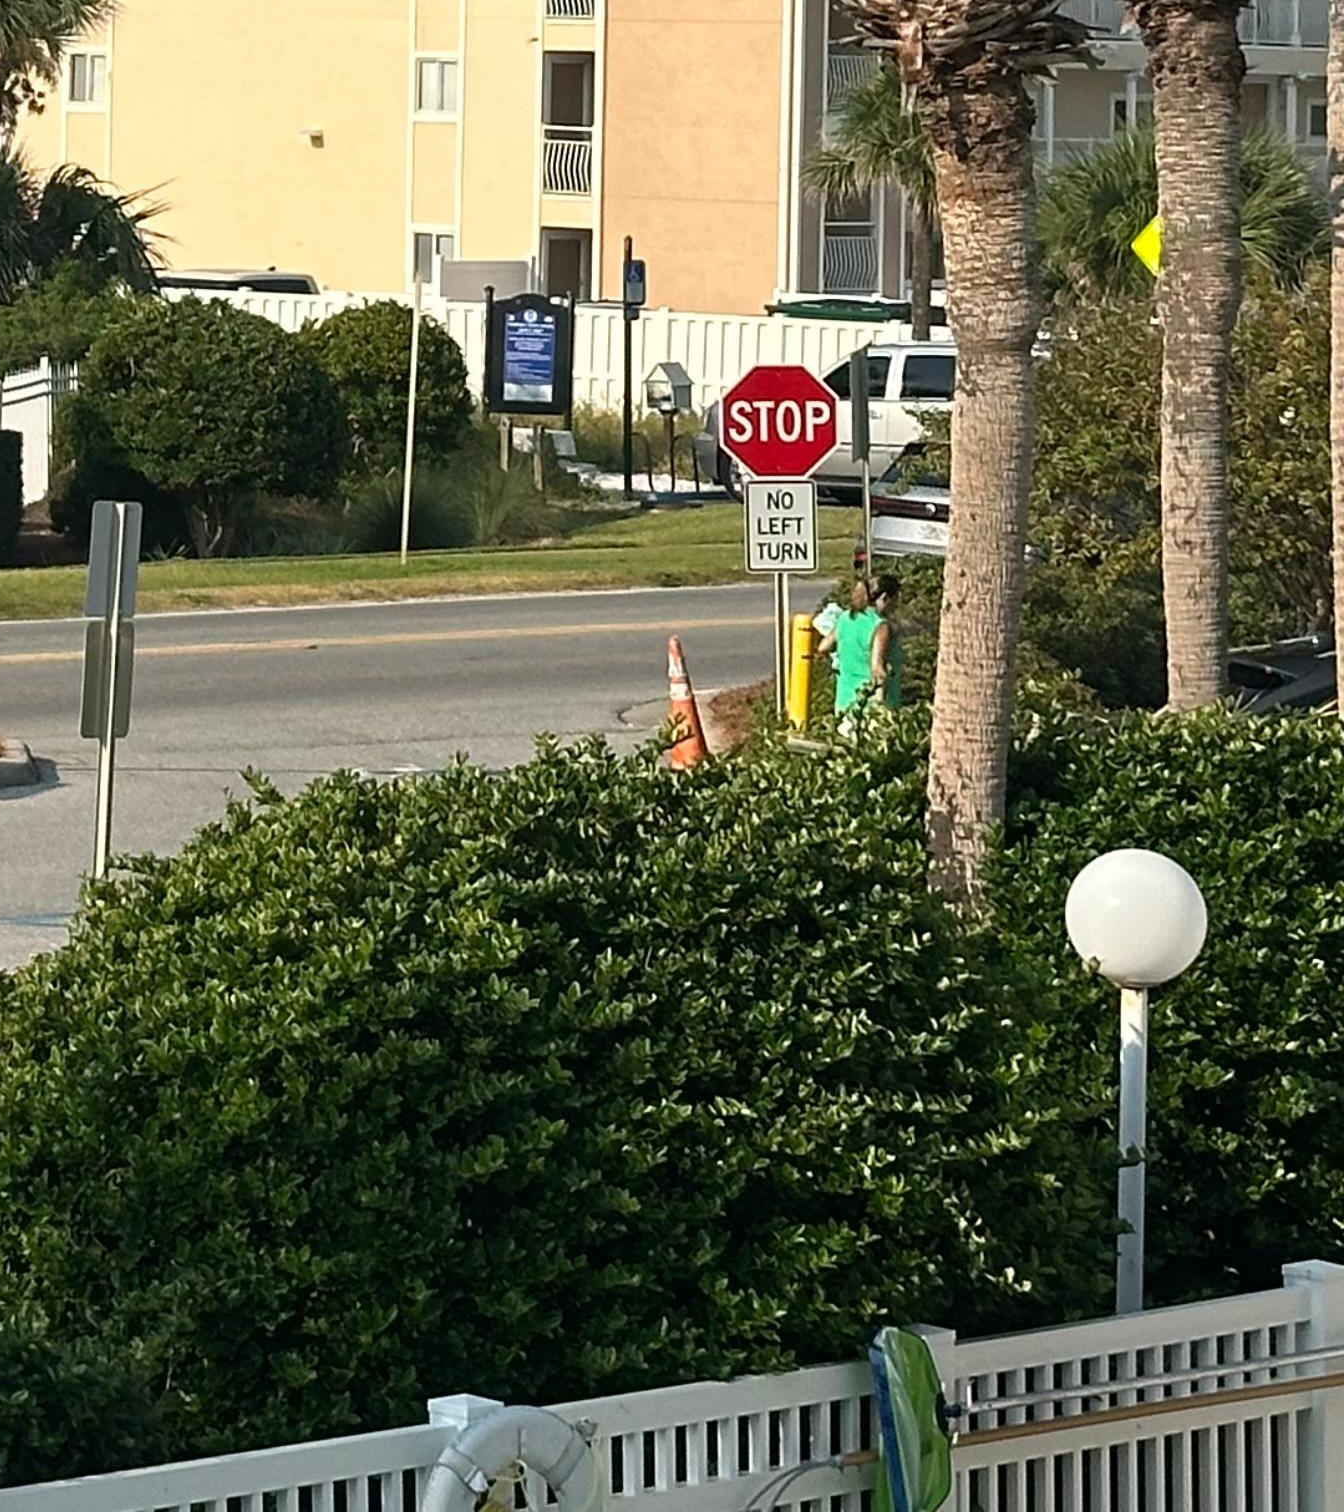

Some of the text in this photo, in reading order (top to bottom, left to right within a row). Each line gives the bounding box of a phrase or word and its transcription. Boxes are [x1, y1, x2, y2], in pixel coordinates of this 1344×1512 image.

[729, 400, 830, 442] STOP
[767, 492, 794, 509] NO
[757, 516, 804, 535] LEFT
[758, 543, 808, 562] TURN
